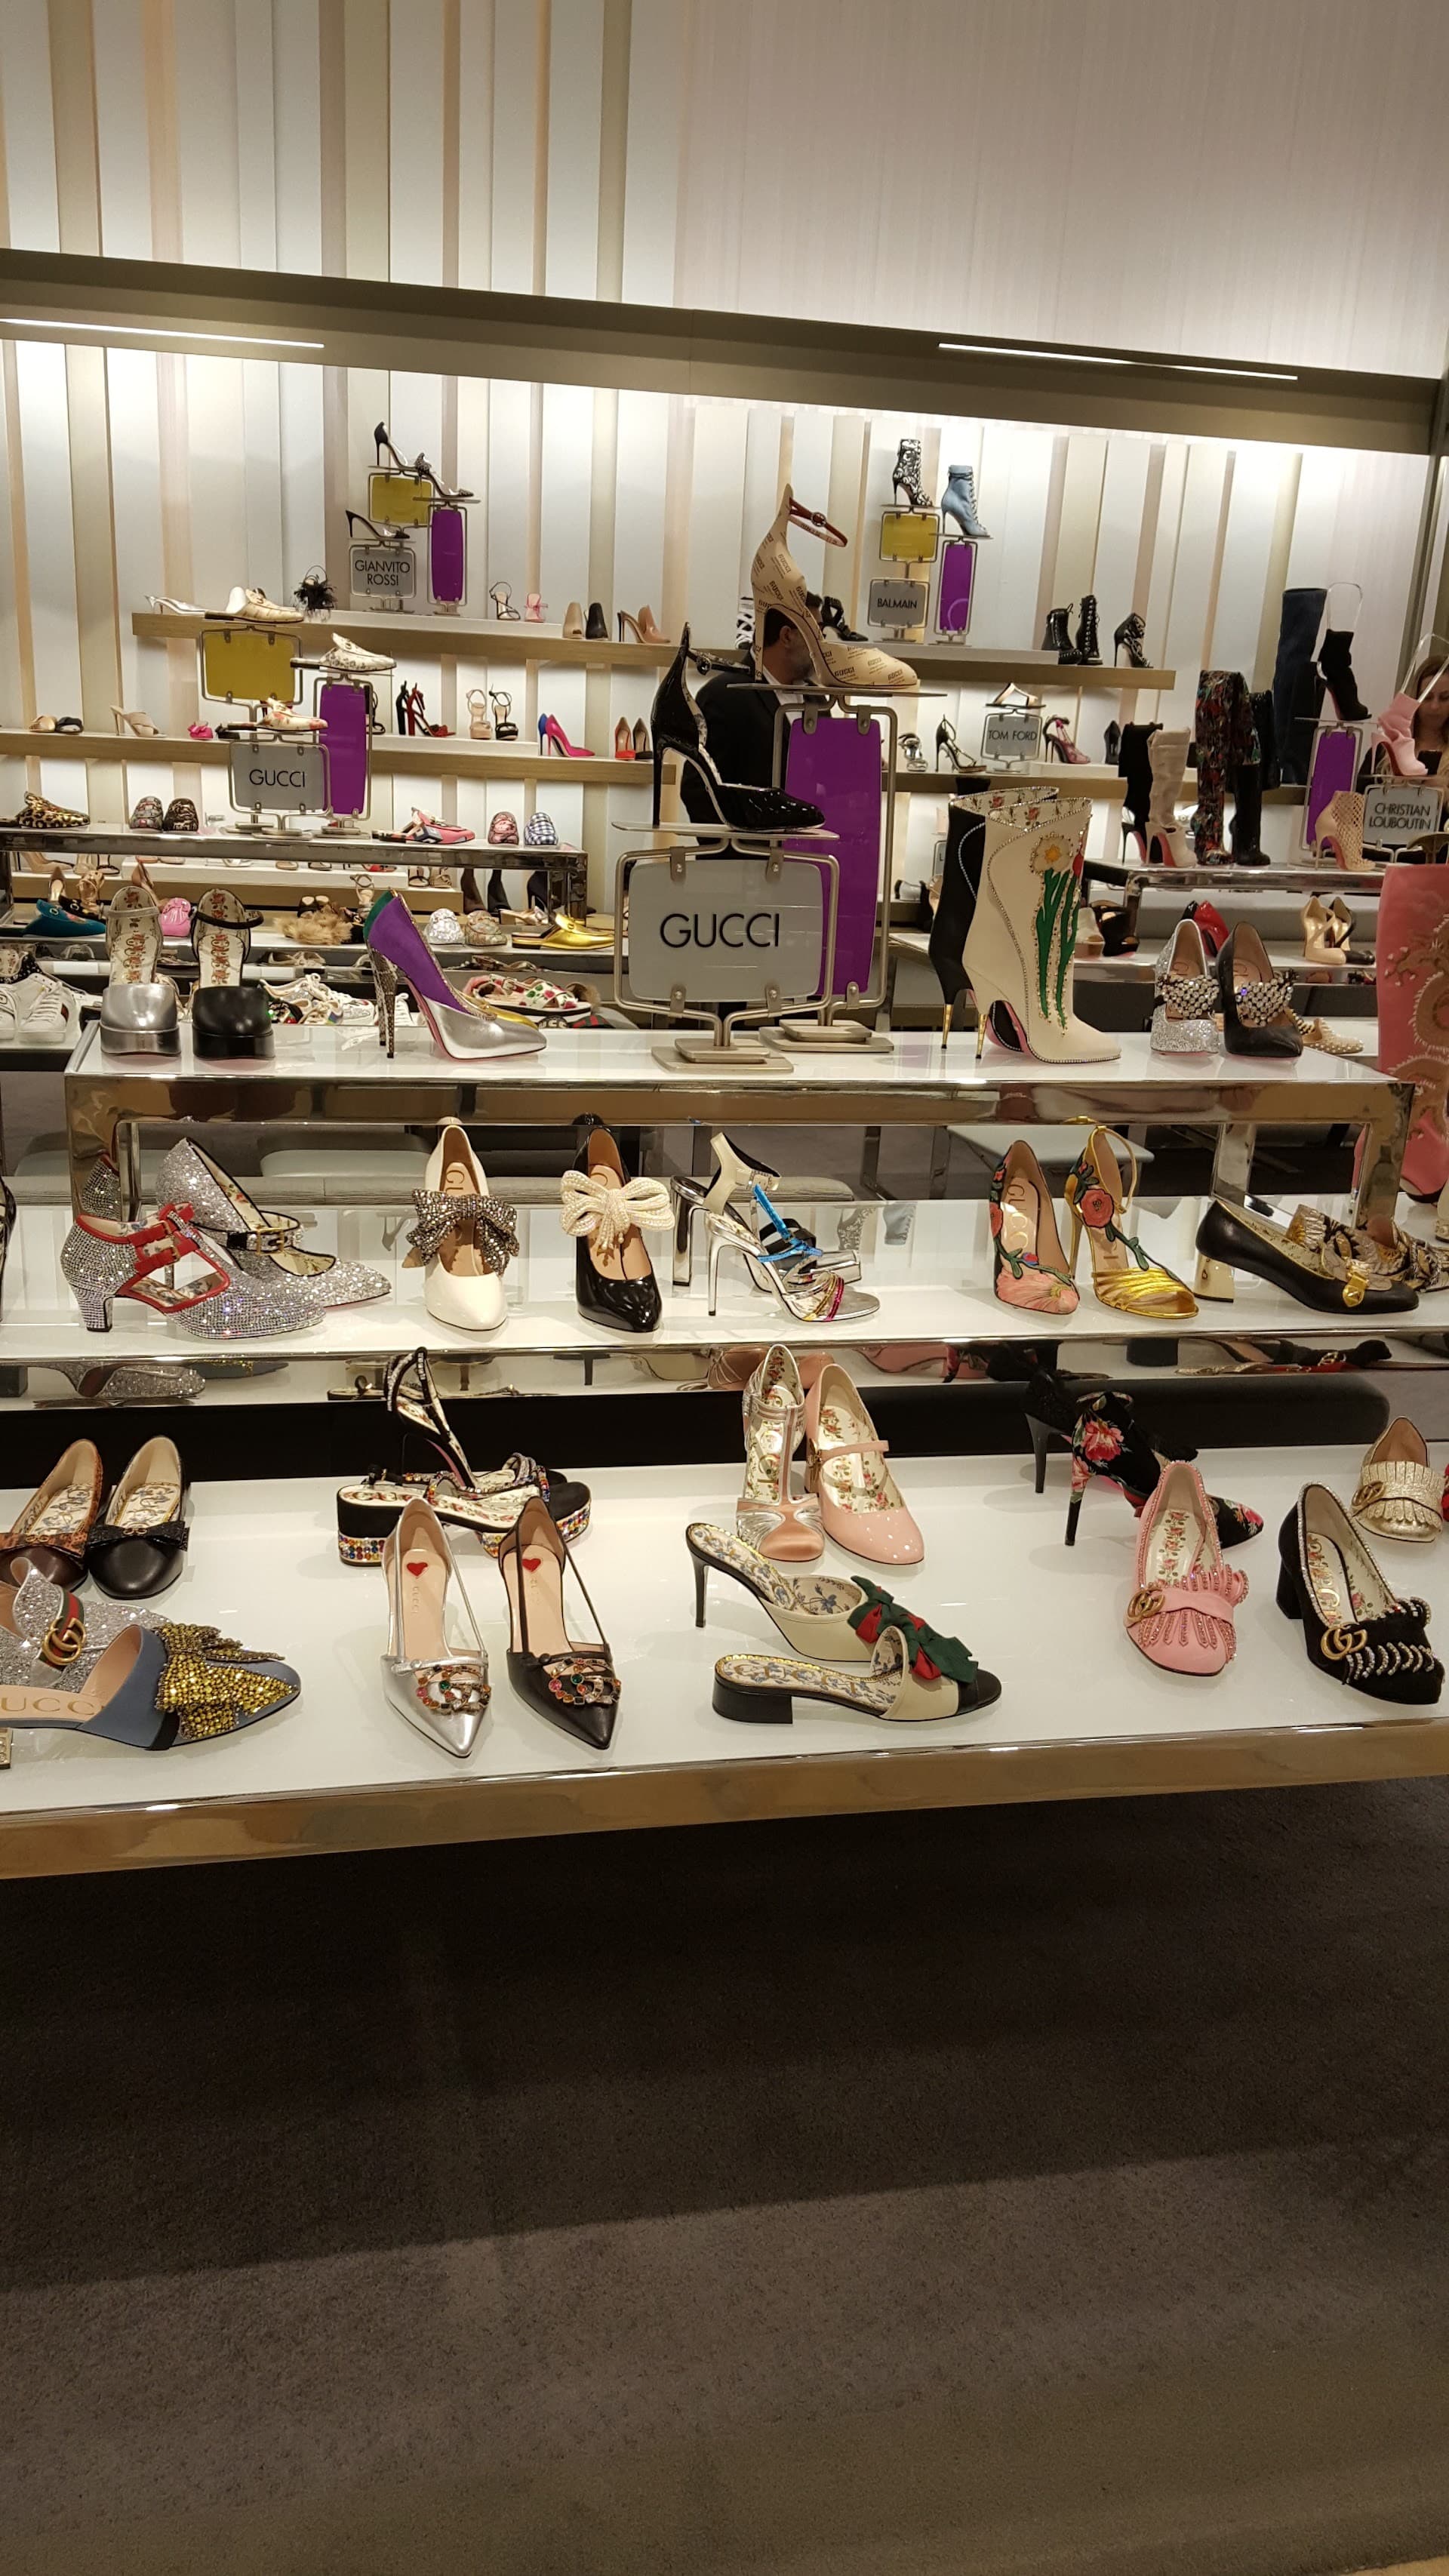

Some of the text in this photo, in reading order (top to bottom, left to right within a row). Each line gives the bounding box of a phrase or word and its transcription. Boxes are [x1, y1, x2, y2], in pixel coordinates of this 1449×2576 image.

[355, 560, 411, 573] GIANVITO
[367, 574, 399, 586] ROSSI
[877, 598, 918, 609] BALMAIN
[834, 666, 855, 678] GUCCI
[988, 730, 1038, 741] TOM FORD
[249, 769, 306, 787] GUCCI
[1375, 802, 1431, 816] CHRISTIAN
[1369, 816, 1432, 829] LOUBOUTIN
[660, 913, 780, 949] GUCCI
